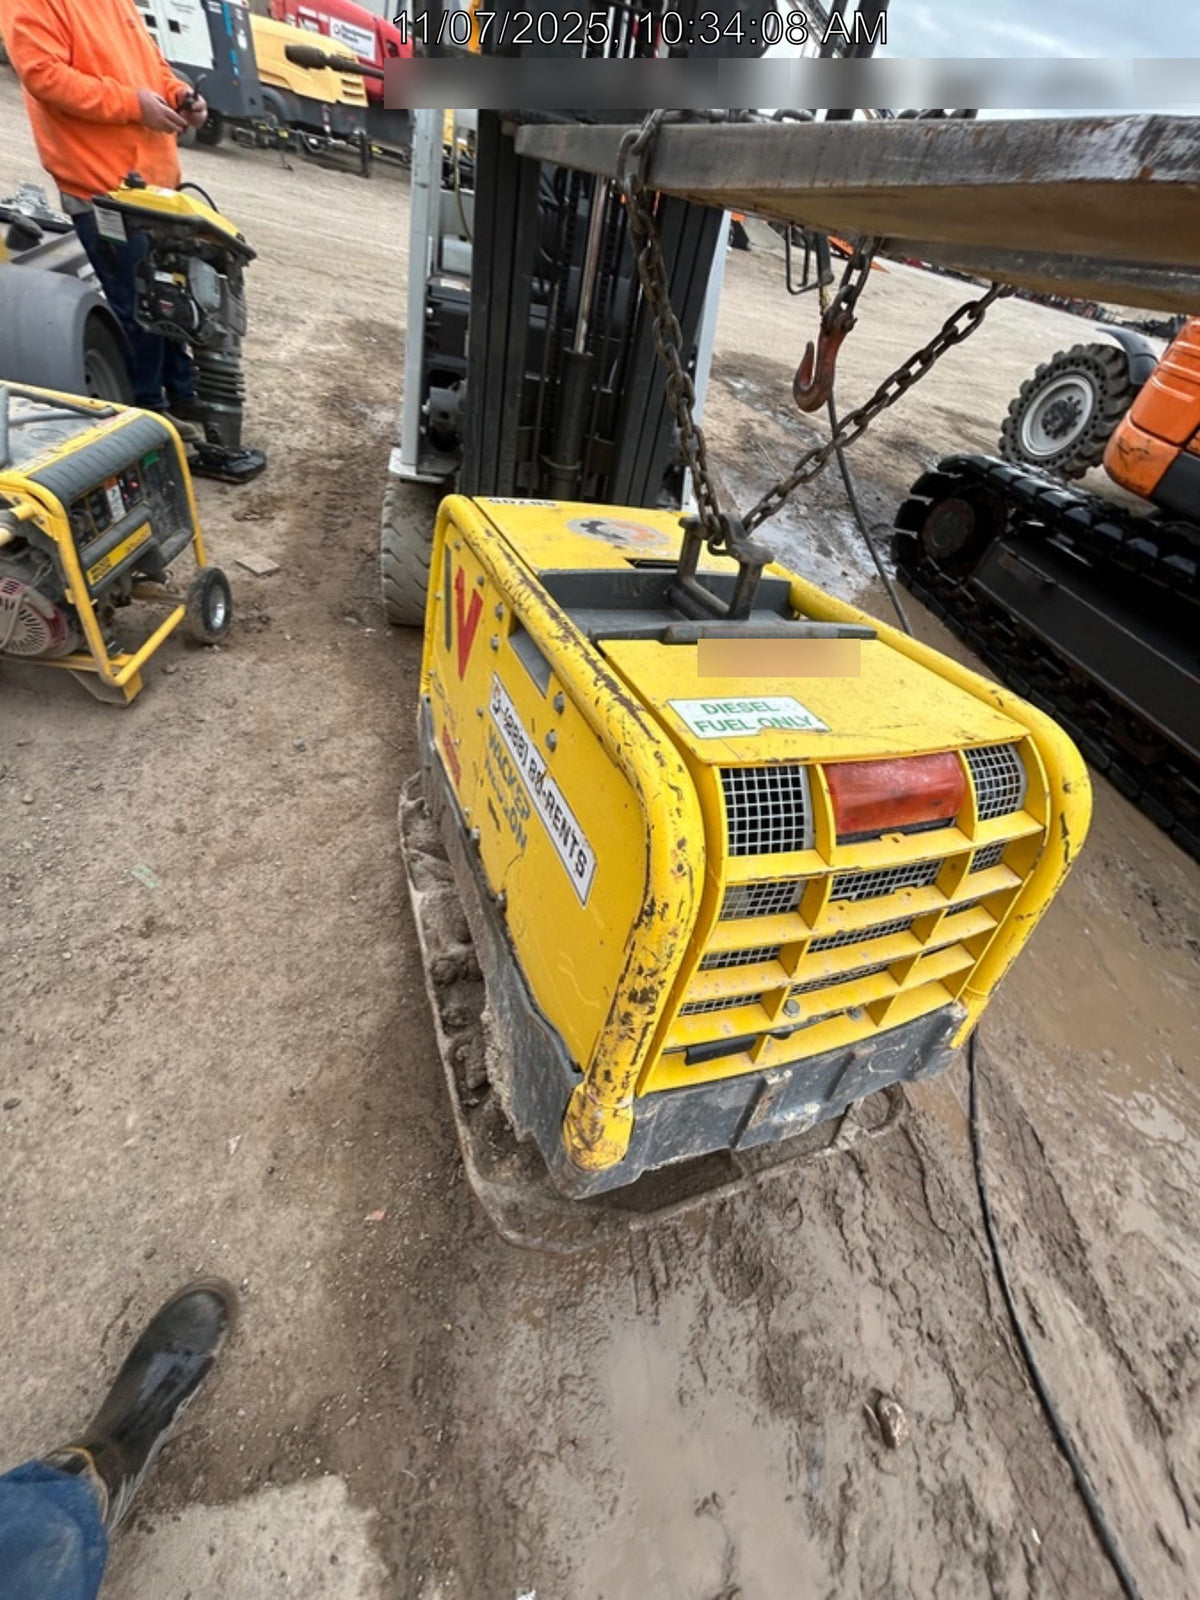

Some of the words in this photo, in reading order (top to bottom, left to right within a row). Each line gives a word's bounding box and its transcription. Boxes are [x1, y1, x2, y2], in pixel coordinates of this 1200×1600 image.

[700, 701, 781, 715] DIESEL
[693, 717, 757, 733] FUEL
[757, 715, 814, 729] ONLY
